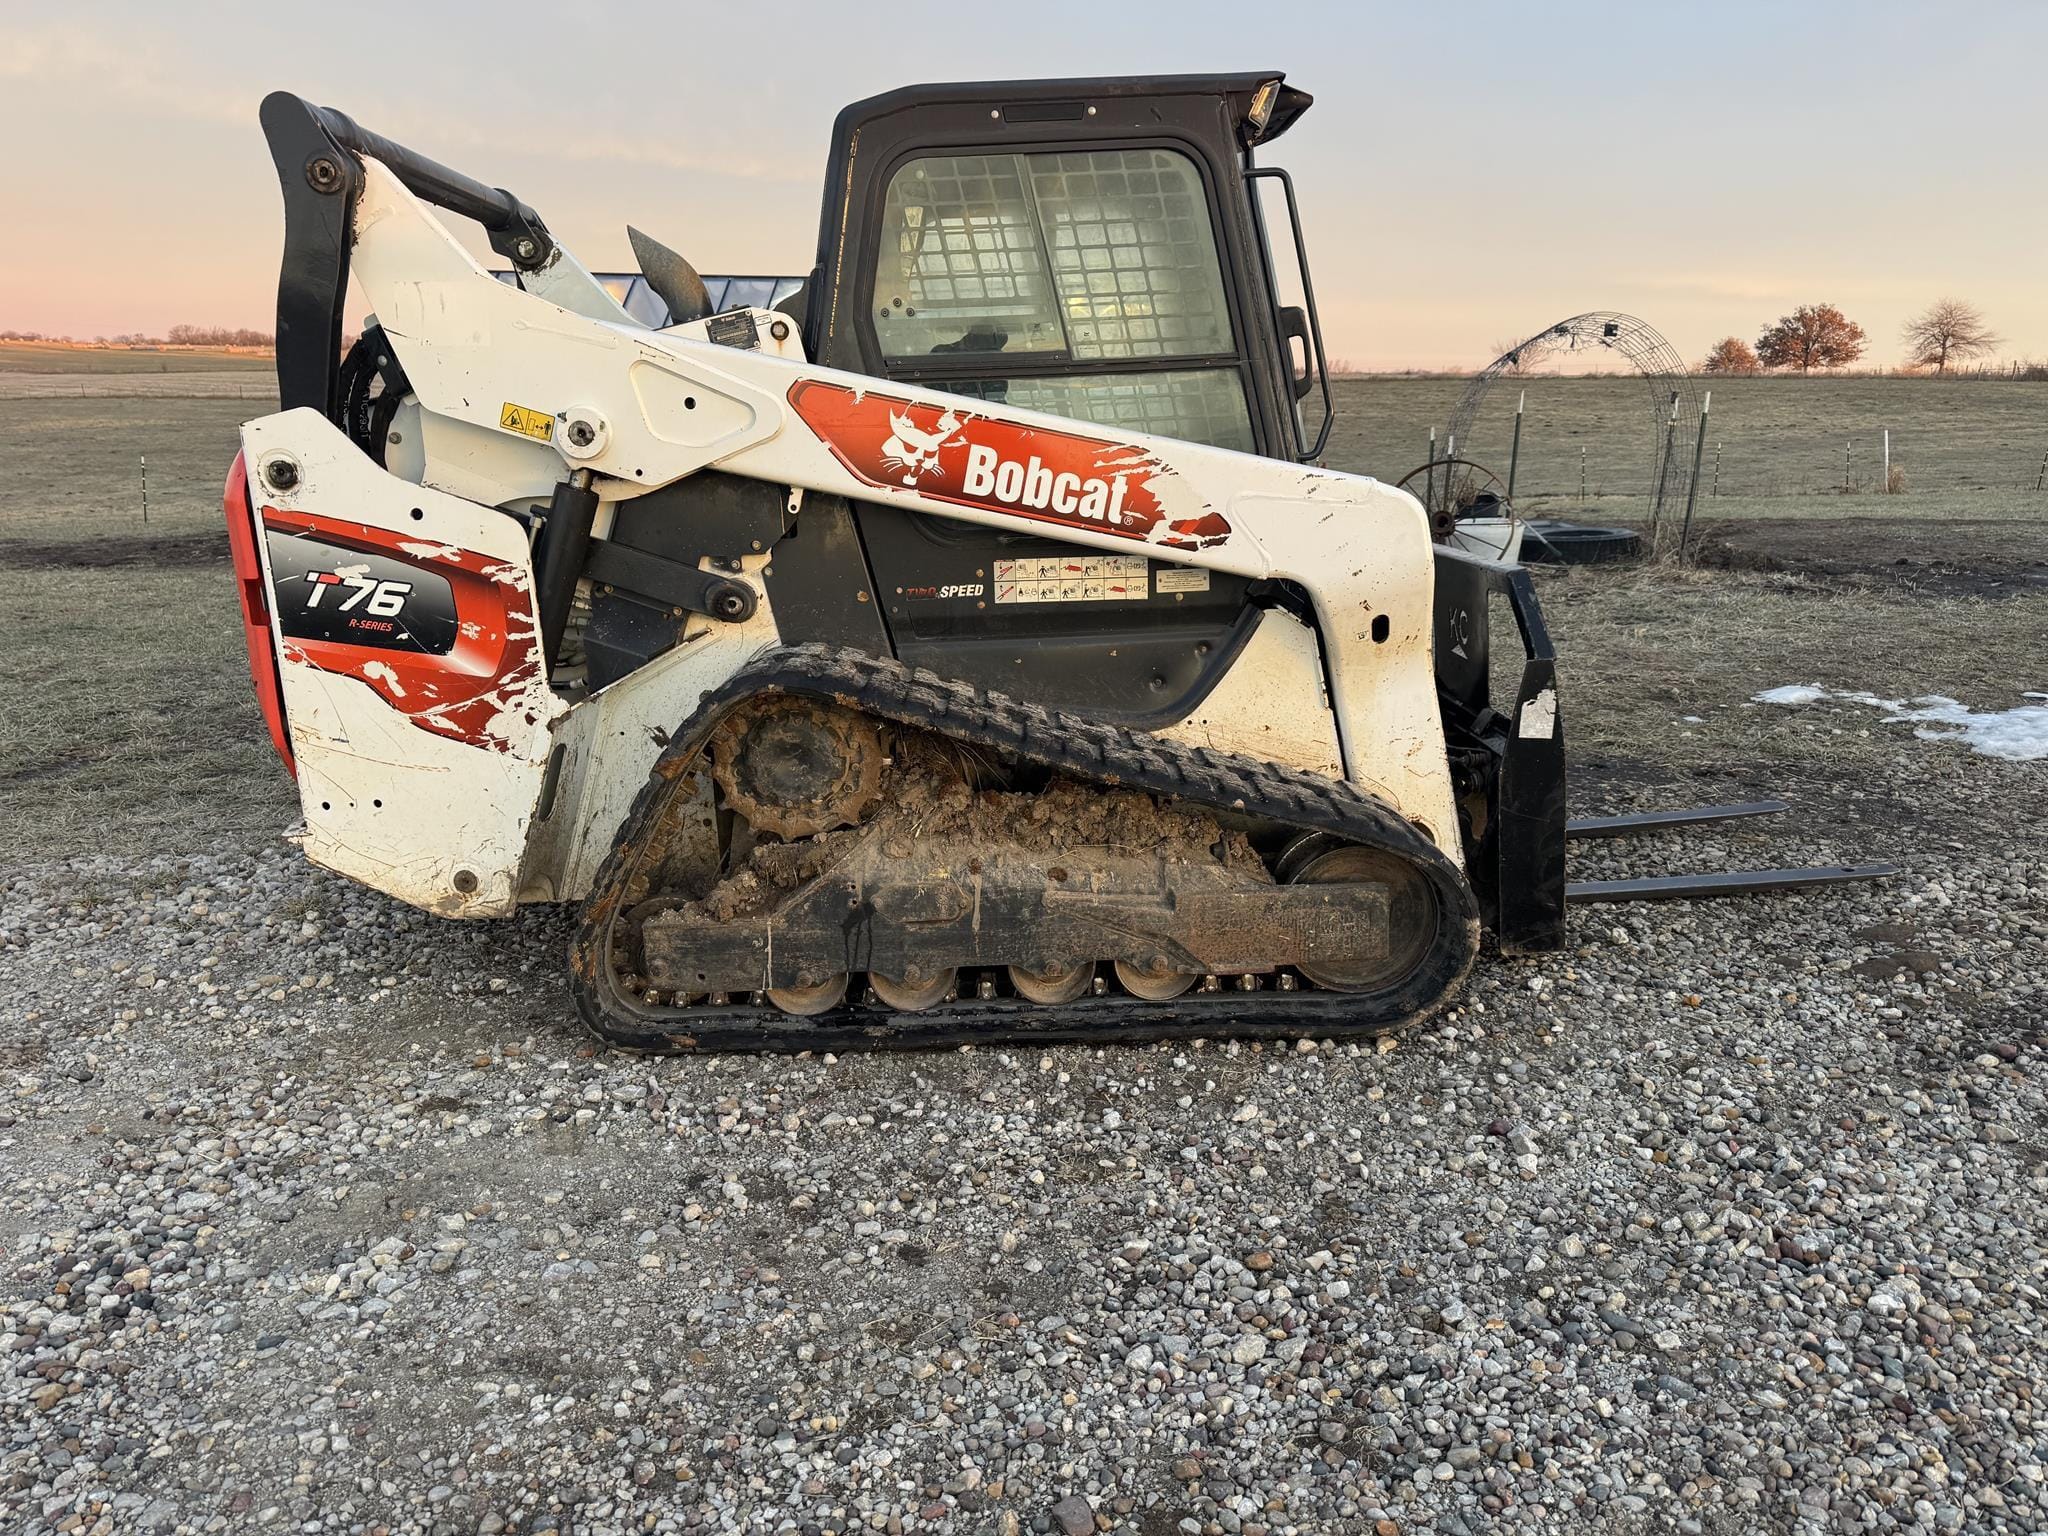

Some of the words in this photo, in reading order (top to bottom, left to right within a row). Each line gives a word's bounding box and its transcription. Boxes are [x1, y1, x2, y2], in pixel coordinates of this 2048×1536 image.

[963, 443, 1128, 524] Bobcat
[306, 571, 412, 617] T76
[940, 584, 984, 598] SPEED
[349, 618, 394, 633] R-SERIES
